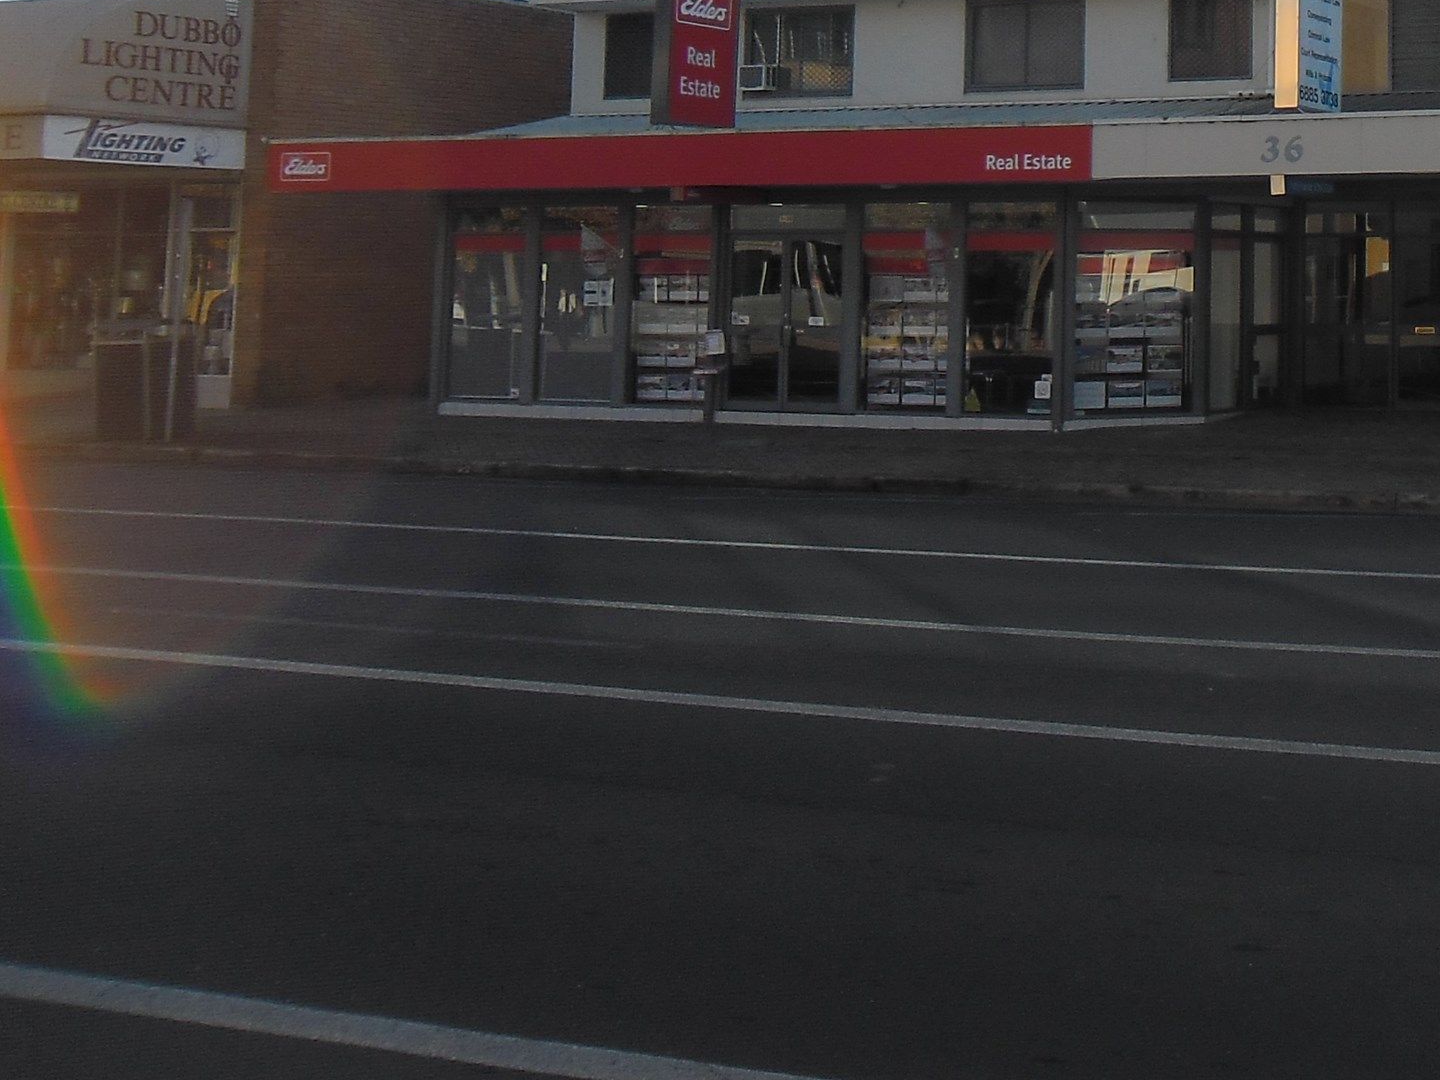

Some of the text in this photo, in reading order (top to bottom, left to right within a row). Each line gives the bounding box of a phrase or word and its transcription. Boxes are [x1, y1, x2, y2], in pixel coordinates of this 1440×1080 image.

[134, 10, 241, 47] DUBBO
[81, 38, 240, 80] LIGHTING
[687, 46, 716, 68] Real
[105, 75, 237, 111] CENTRE
[680, 76, 721, 99] Estate
[986, 153, 1072, 170] Real Estate
[1260, 135, 1305, 162] 36
